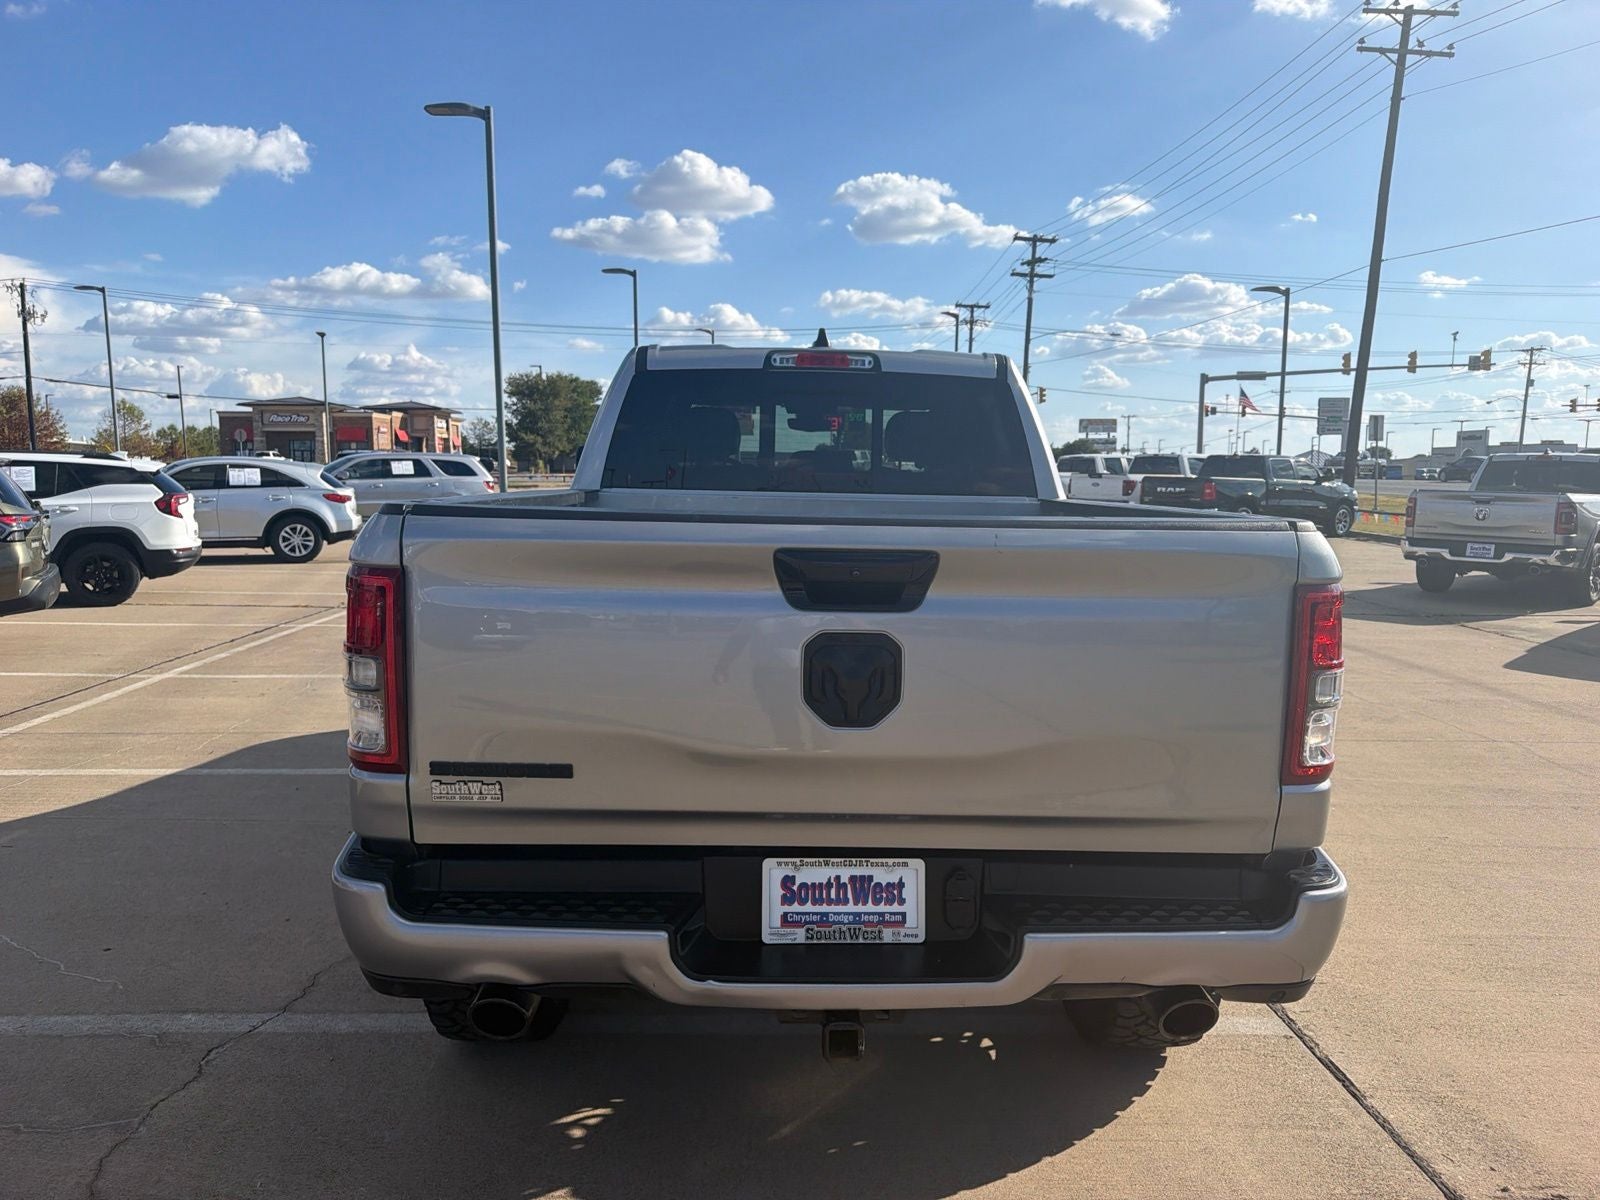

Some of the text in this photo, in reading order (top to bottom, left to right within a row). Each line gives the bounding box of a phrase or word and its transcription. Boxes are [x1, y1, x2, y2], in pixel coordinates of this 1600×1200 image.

[268, 413, 310, 423] RaceTrac
[431, 780, 502, 794] SouthWest
[780, 874, 906, 907] SouthWest
[787, 913, 903, 923] Chrysler Dodge Jeep Ram
[804, 926, 883, 941] SouthWest
